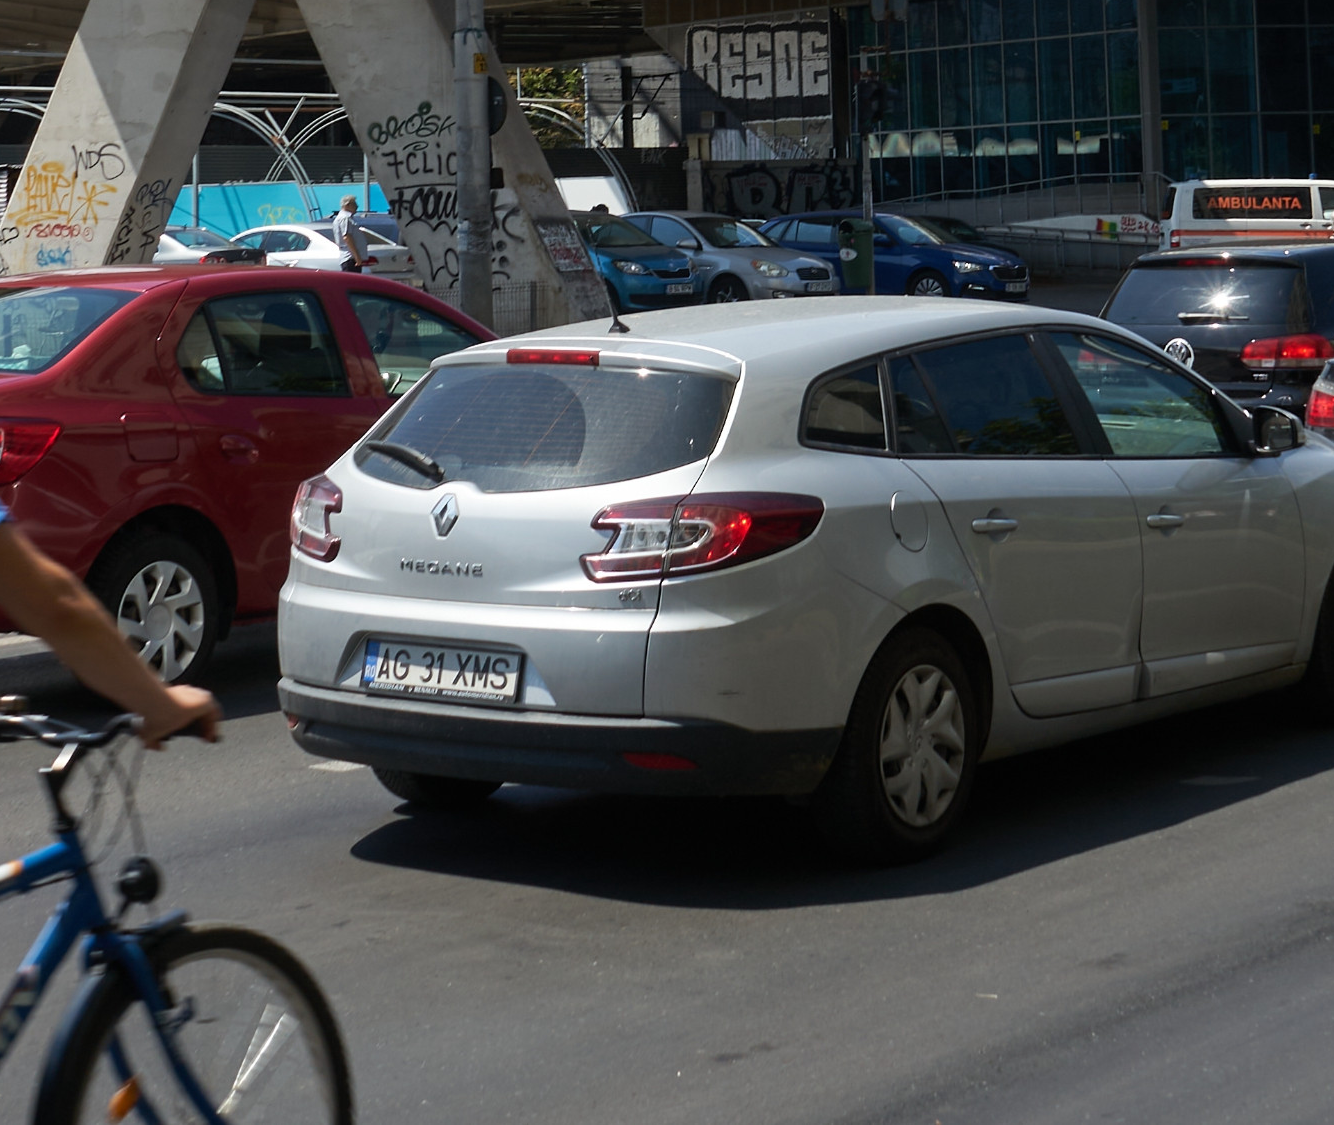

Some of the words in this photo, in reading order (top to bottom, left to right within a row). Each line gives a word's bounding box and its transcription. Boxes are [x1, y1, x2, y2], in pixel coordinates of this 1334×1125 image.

[1207, 196, 1302, 210] AMBULANTA
[399, 556, 484, 578] MEGANE
[377, 647, 412, 681] AG
[419, 651, 446, 685] 31
[452, 653, 511, 691] XMS
